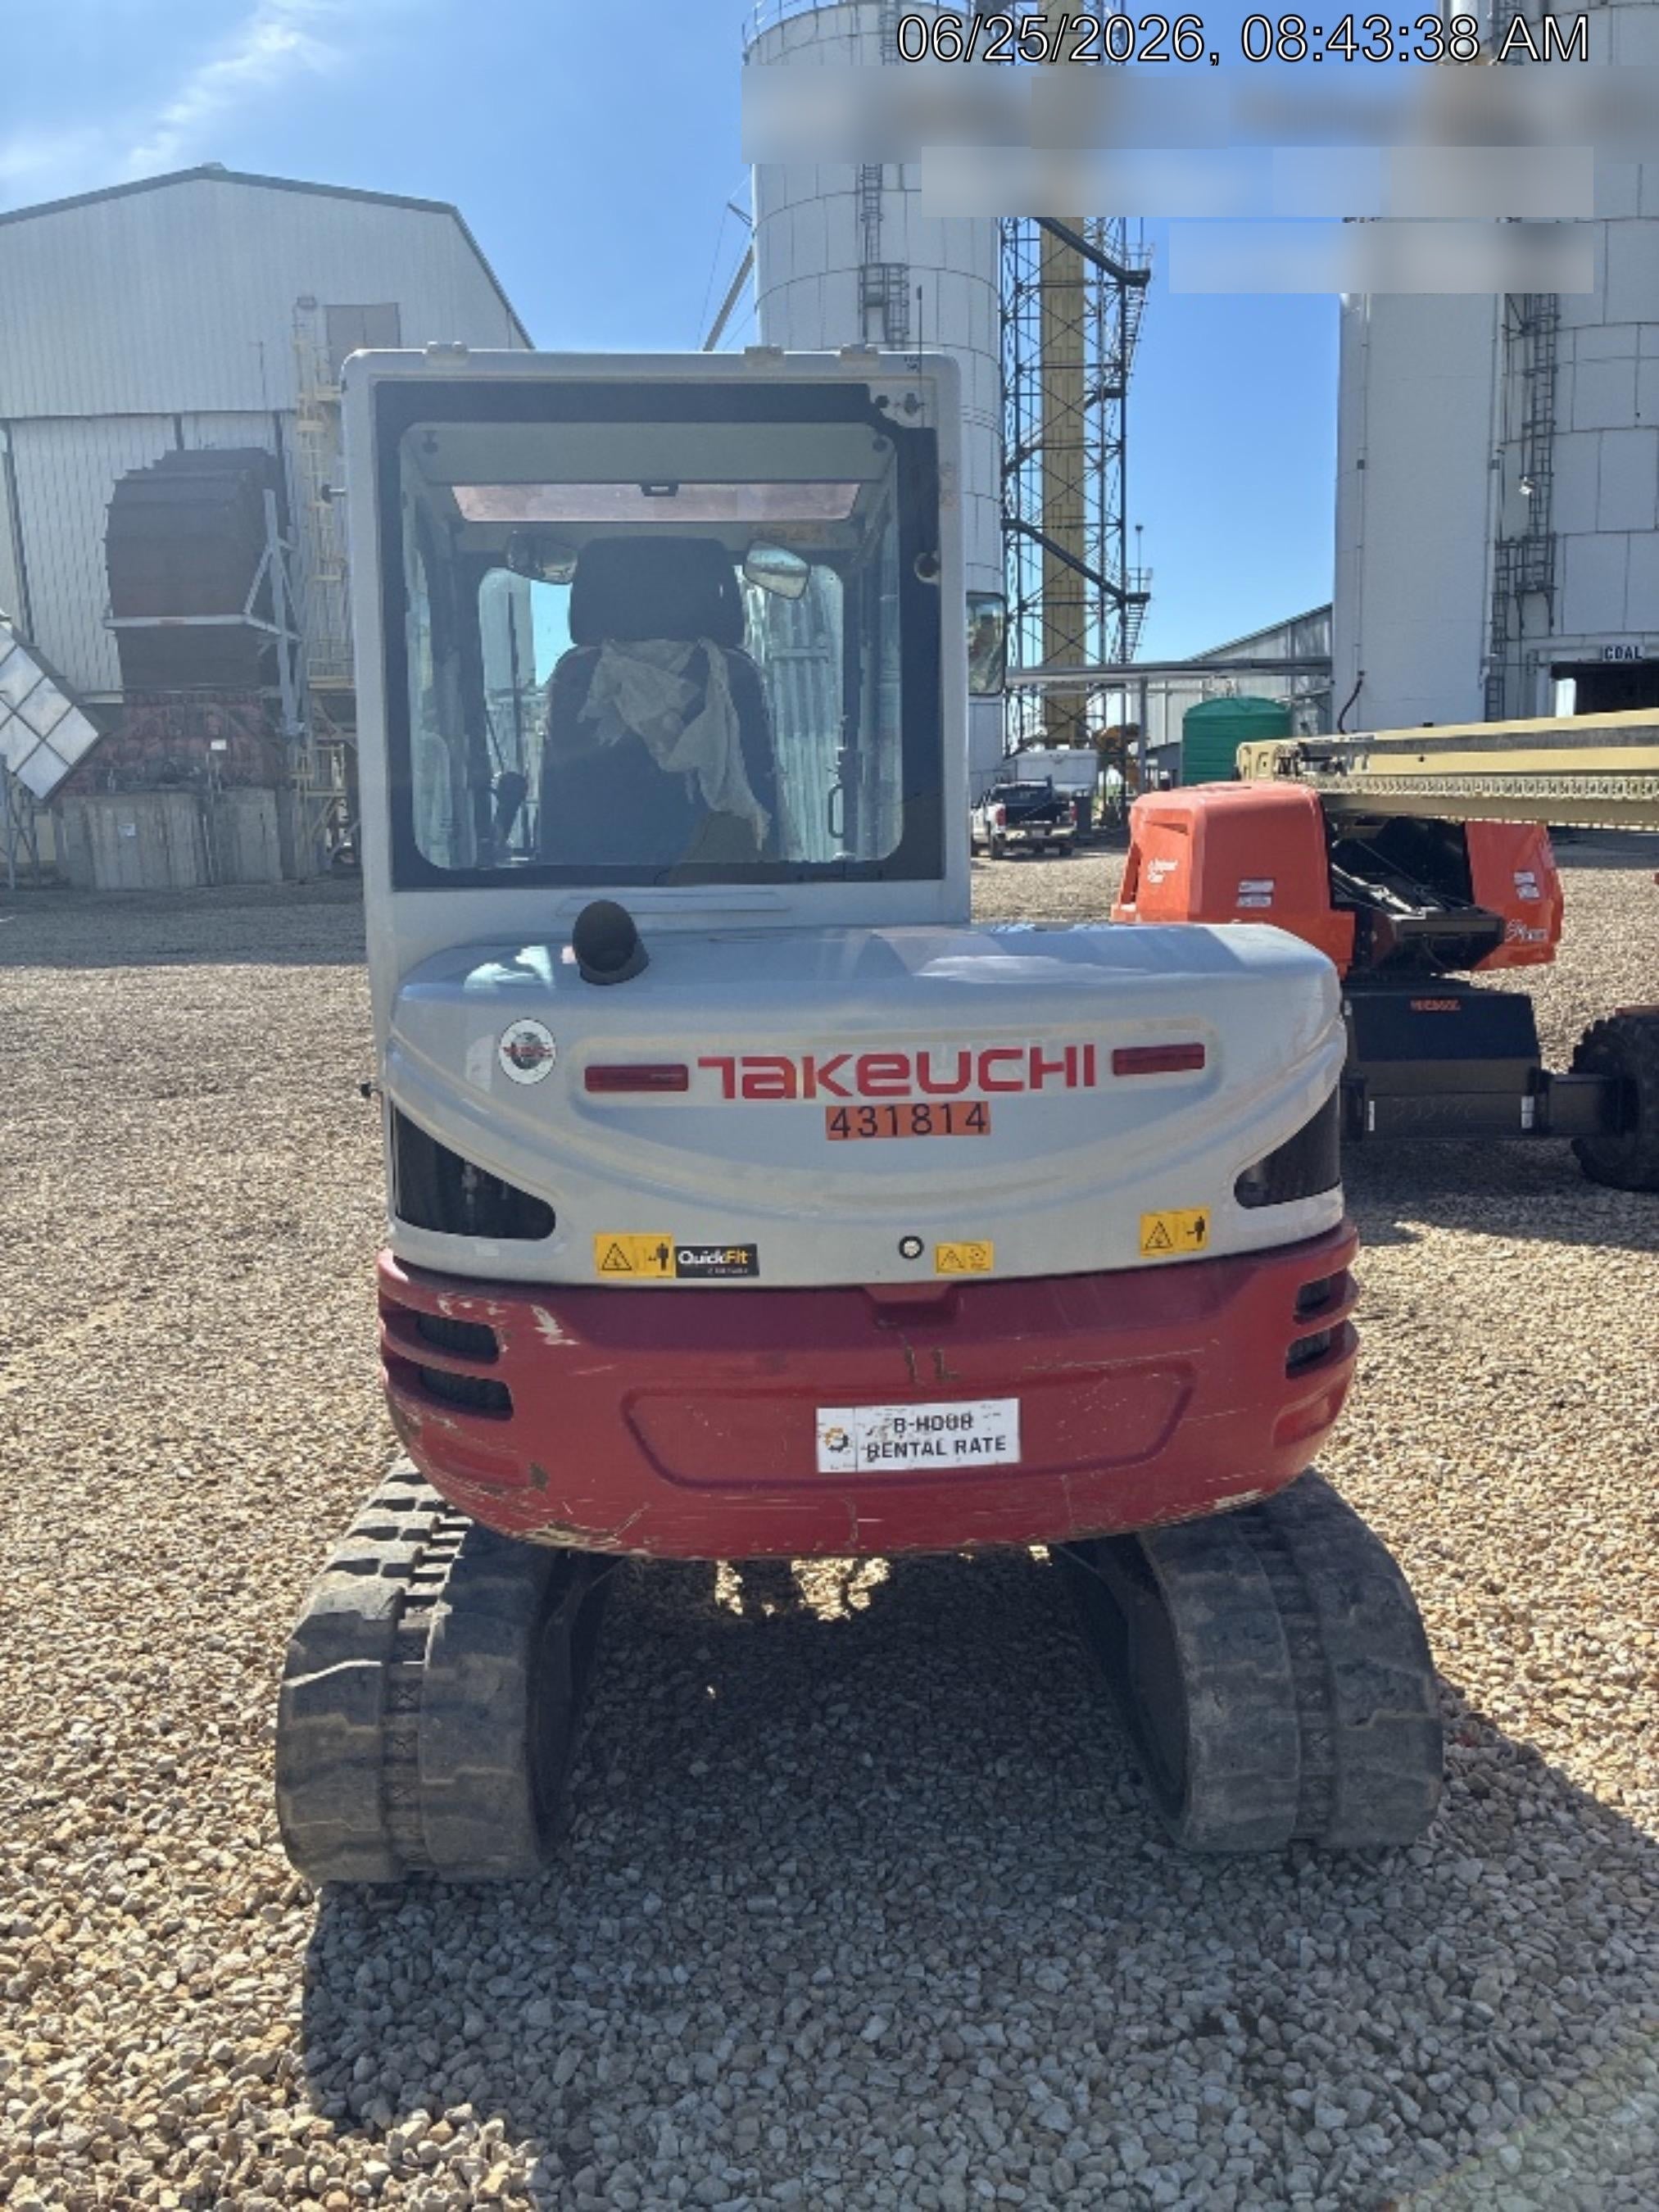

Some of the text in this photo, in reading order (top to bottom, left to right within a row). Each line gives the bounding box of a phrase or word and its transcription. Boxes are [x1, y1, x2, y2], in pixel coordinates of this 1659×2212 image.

[1604, 646, 1643, 660] COAL
[829, 1102, 987, 1138] 431814
[678, 1249, 748, 1265] QuickFit
[866, 1435, 1006, 1462] RENTAL RATE
